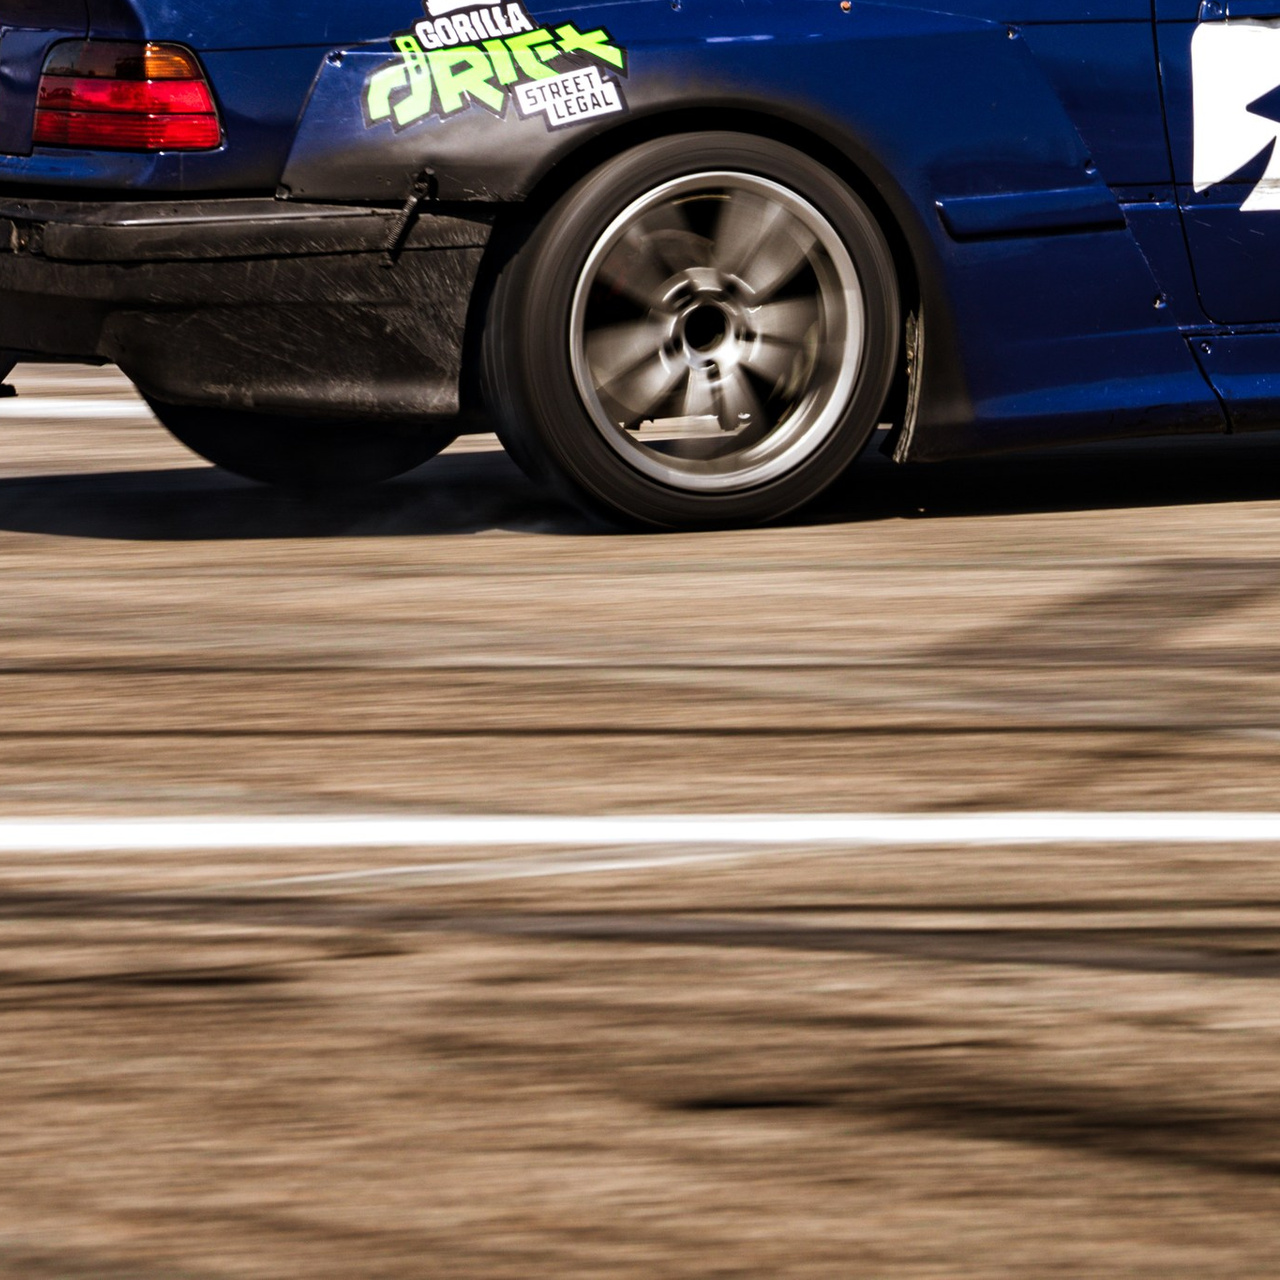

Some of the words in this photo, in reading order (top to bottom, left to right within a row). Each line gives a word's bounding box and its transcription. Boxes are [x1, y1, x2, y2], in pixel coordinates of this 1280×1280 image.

[415, 2, 534, 49] GORILLA
[524, 72, 594, 107] STREET
[552, 89, 614, 120] LEGAL
